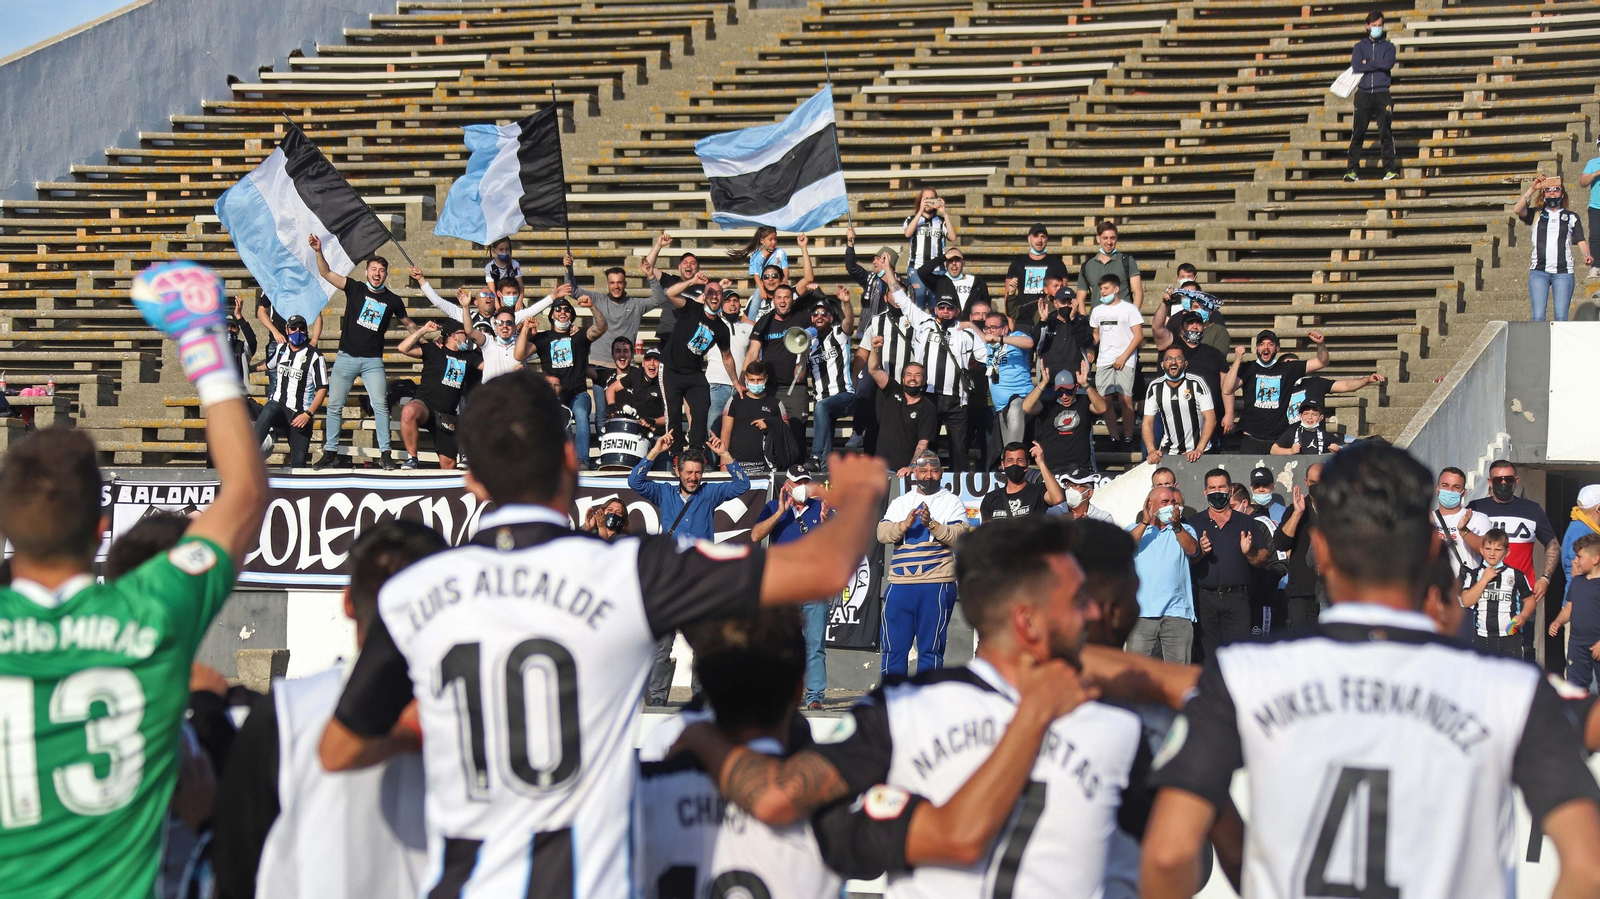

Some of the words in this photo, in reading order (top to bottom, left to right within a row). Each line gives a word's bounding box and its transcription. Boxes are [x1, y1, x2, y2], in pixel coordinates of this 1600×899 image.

[277, 366, 304, 381] OTUS
[602, 438, 638, 452] LINENSE
[117, 486, 216, 504] BALONA
[406, 577, 463, 634] LUIS
[473, 566, 615, 631] ALCALDE
[59, 613, 159, 660] MIRAS
[431, 637, 583, 803] 10
[1253, 678, 1333, 739] MIKEL
[0, 667, 148, 829] 13
[912, 717, 997, 782] NACHO
[1288, 761, 1405, 899] 4
